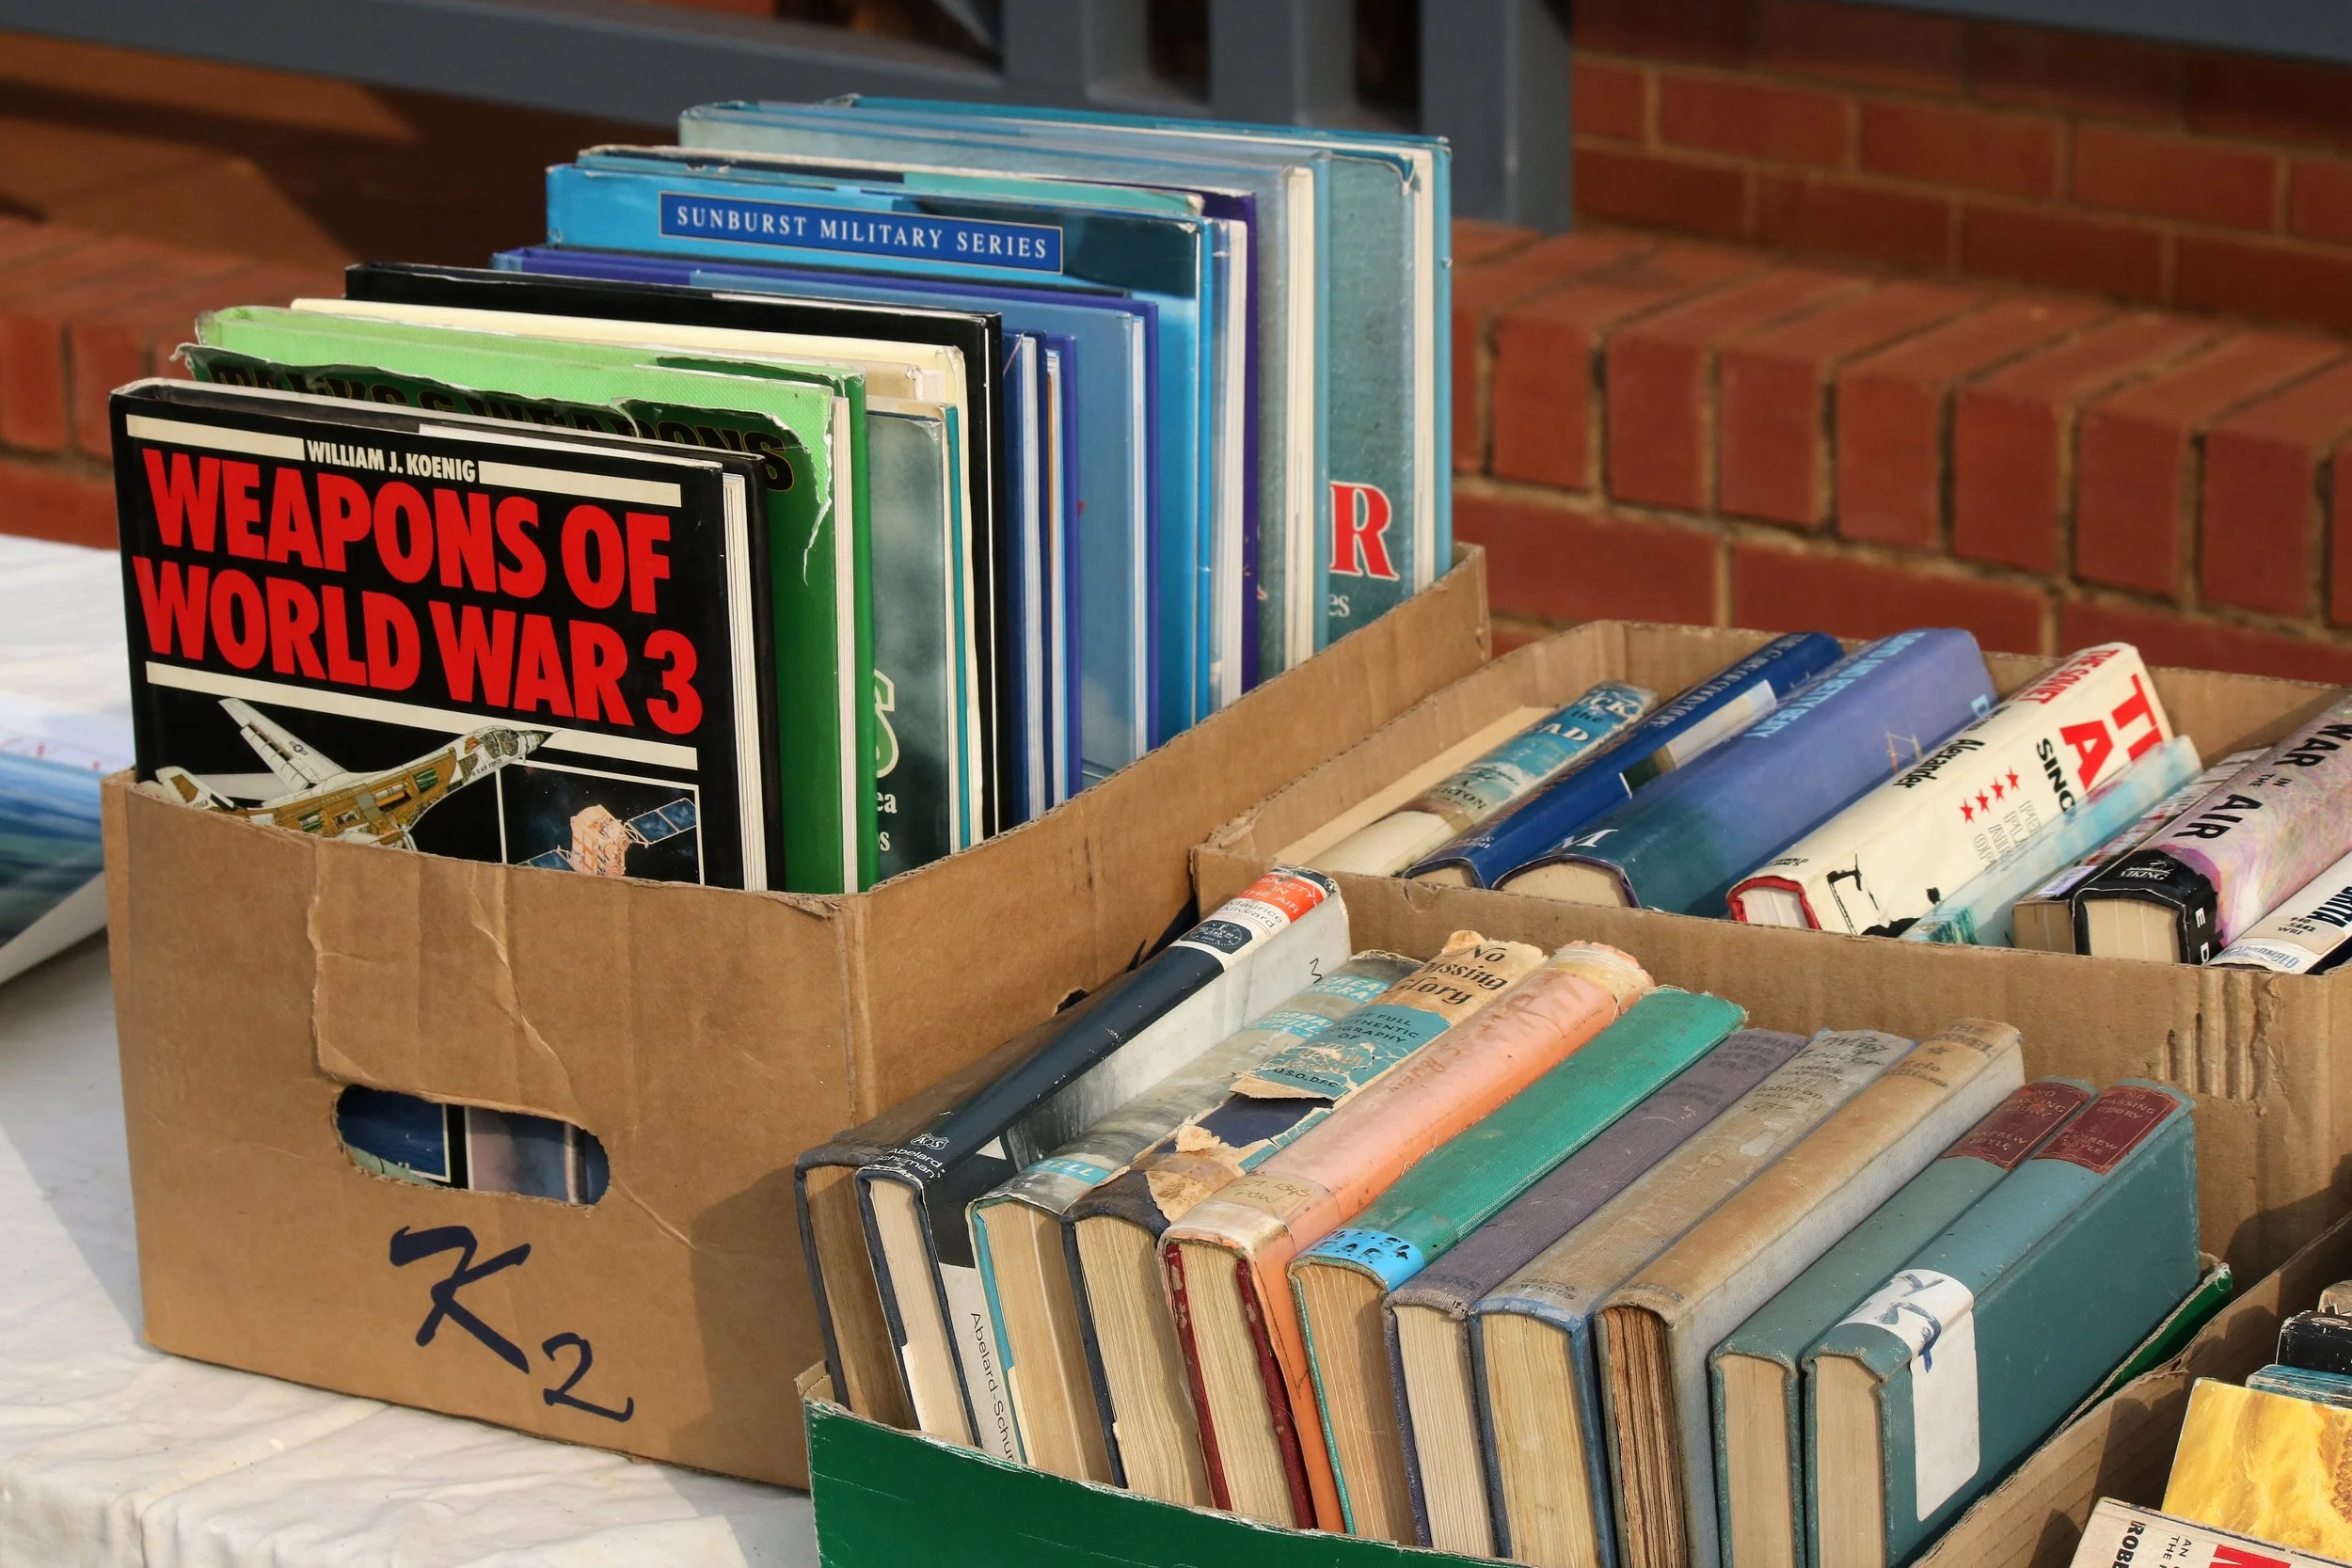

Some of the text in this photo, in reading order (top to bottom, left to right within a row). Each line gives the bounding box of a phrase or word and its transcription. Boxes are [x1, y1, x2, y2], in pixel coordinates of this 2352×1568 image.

[676, 205, 1047, 261] SUNBURST MILITARY SERIES
[306, 439, 476, 483] WILLIAM J. KOENIG
[142, 447, 672, 614] WEAPONS OF
[132, 555, 704, 736] WORLD WAR 3
[1892, 737, 1986, 790] Alexander
[2171, 793, 2264, 840] AIR
[2119, 870, 2168, 880] VIKING
[1228, 899, 1283, 924] Maurice
[1276, 896, 1300, 913] AIR
[1376, 1014, 1412, 1026] FULL
[2162, 1536, 2180, 1561] THE
[2178, 1539, 2192, 1558] AN
